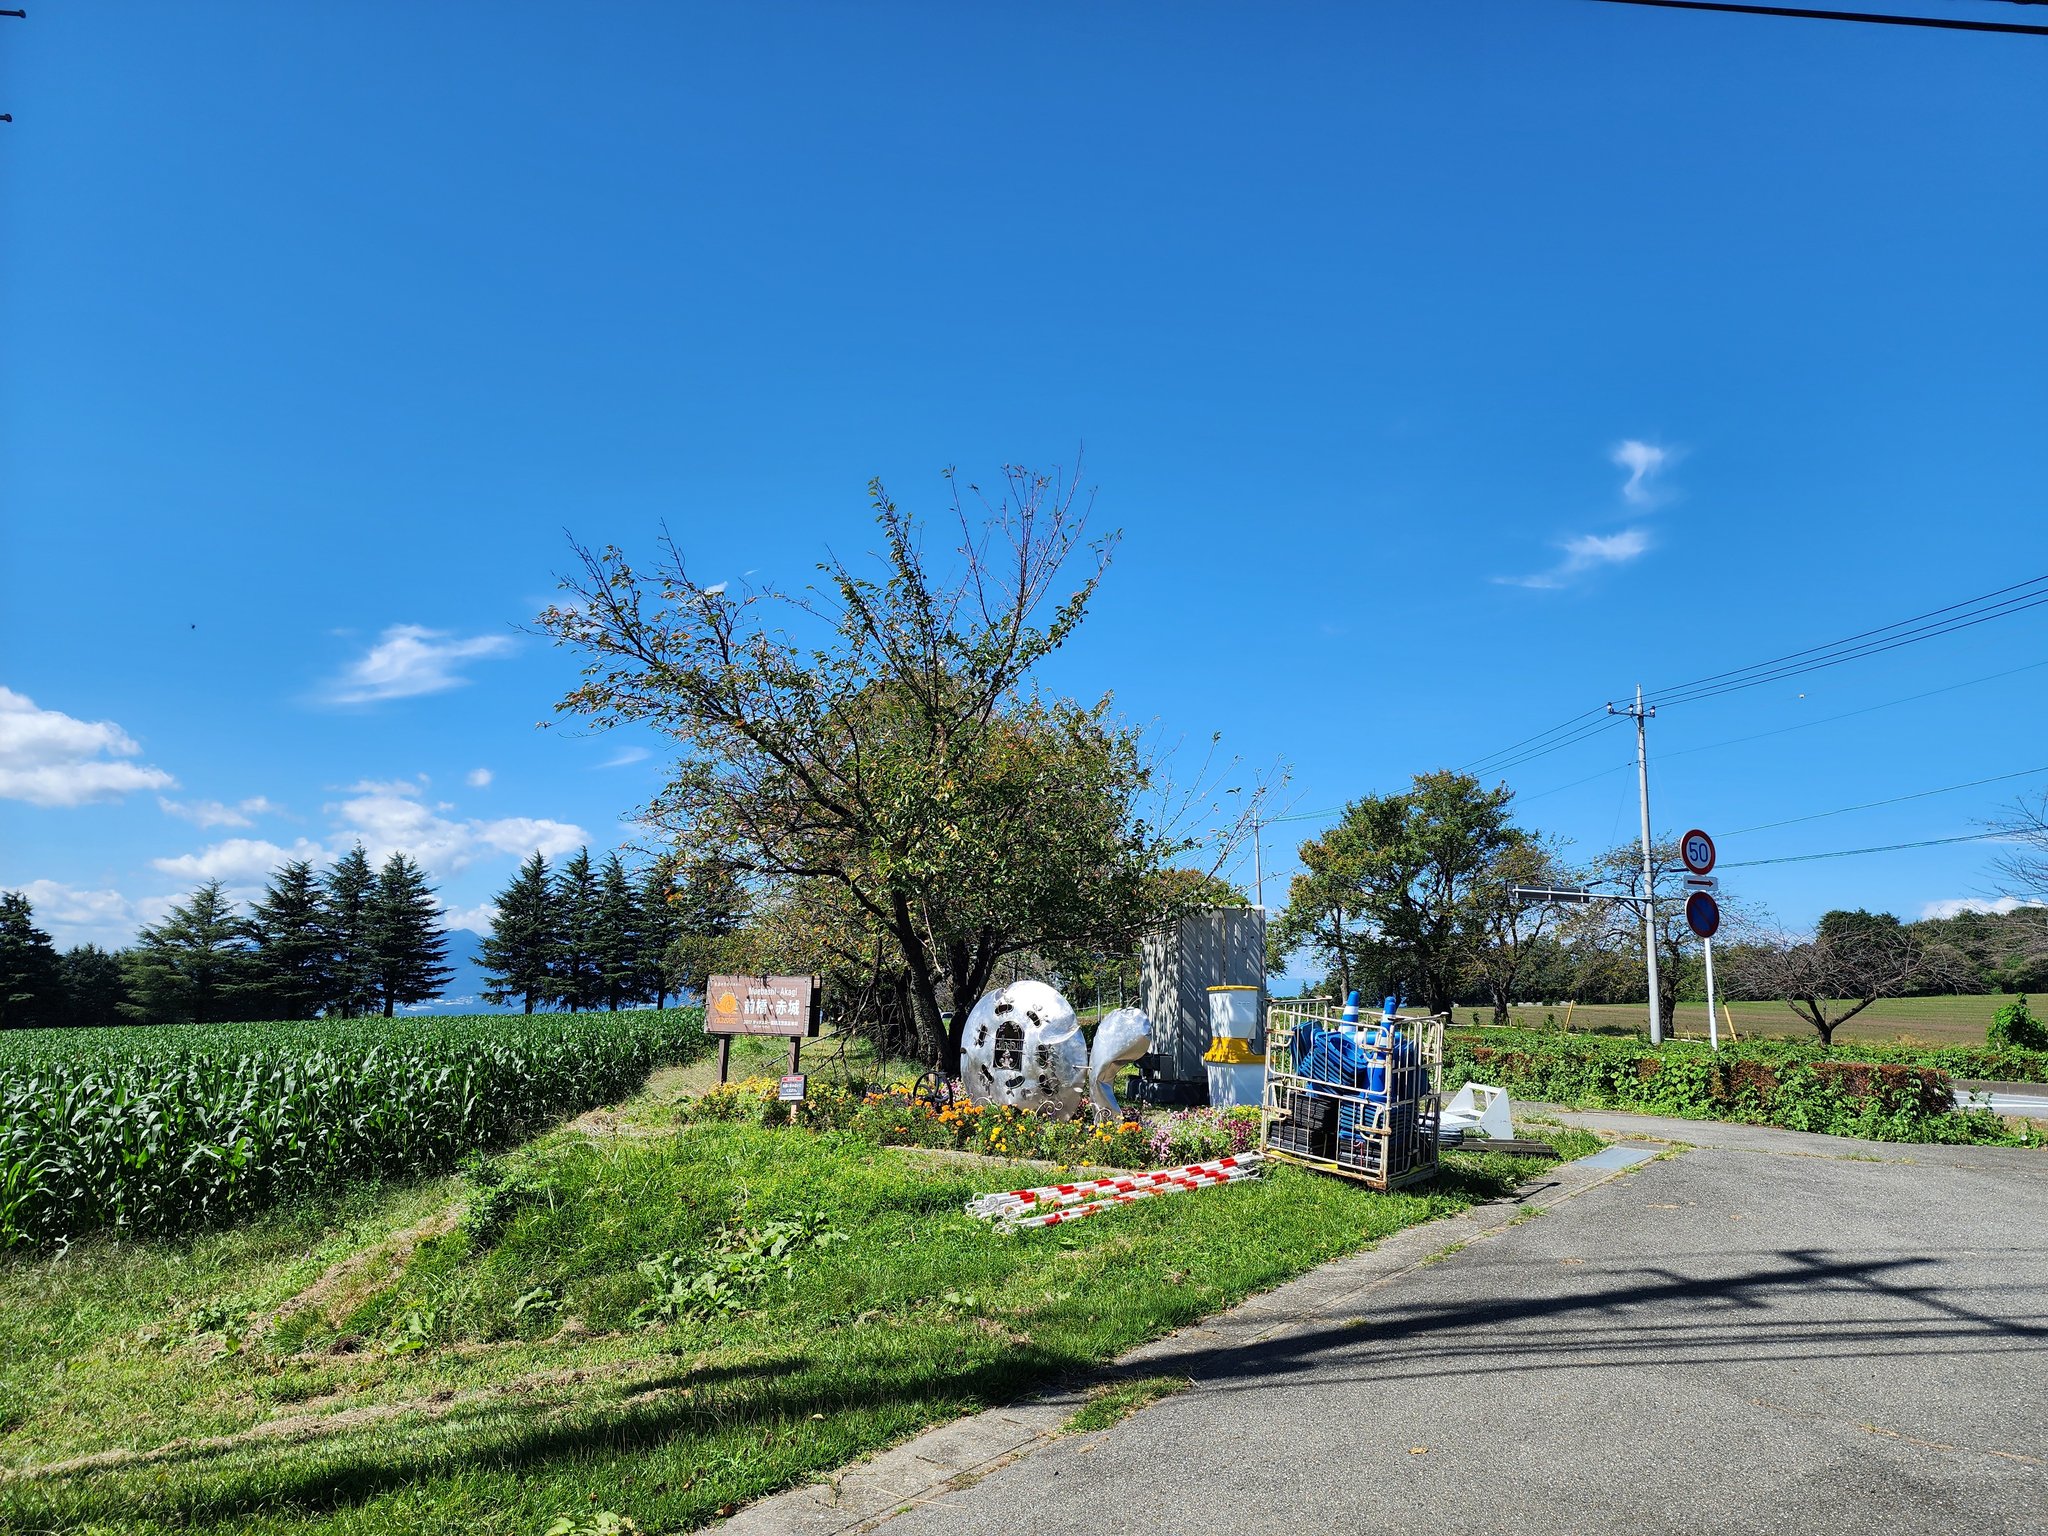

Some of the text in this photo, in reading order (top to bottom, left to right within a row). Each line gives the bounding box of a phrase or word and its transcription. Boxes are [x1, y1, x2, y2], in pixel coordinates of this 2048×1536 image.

[1689, 842, 1708, 862] 50
[744, 999, 800, 1015] 前橋・赤城
